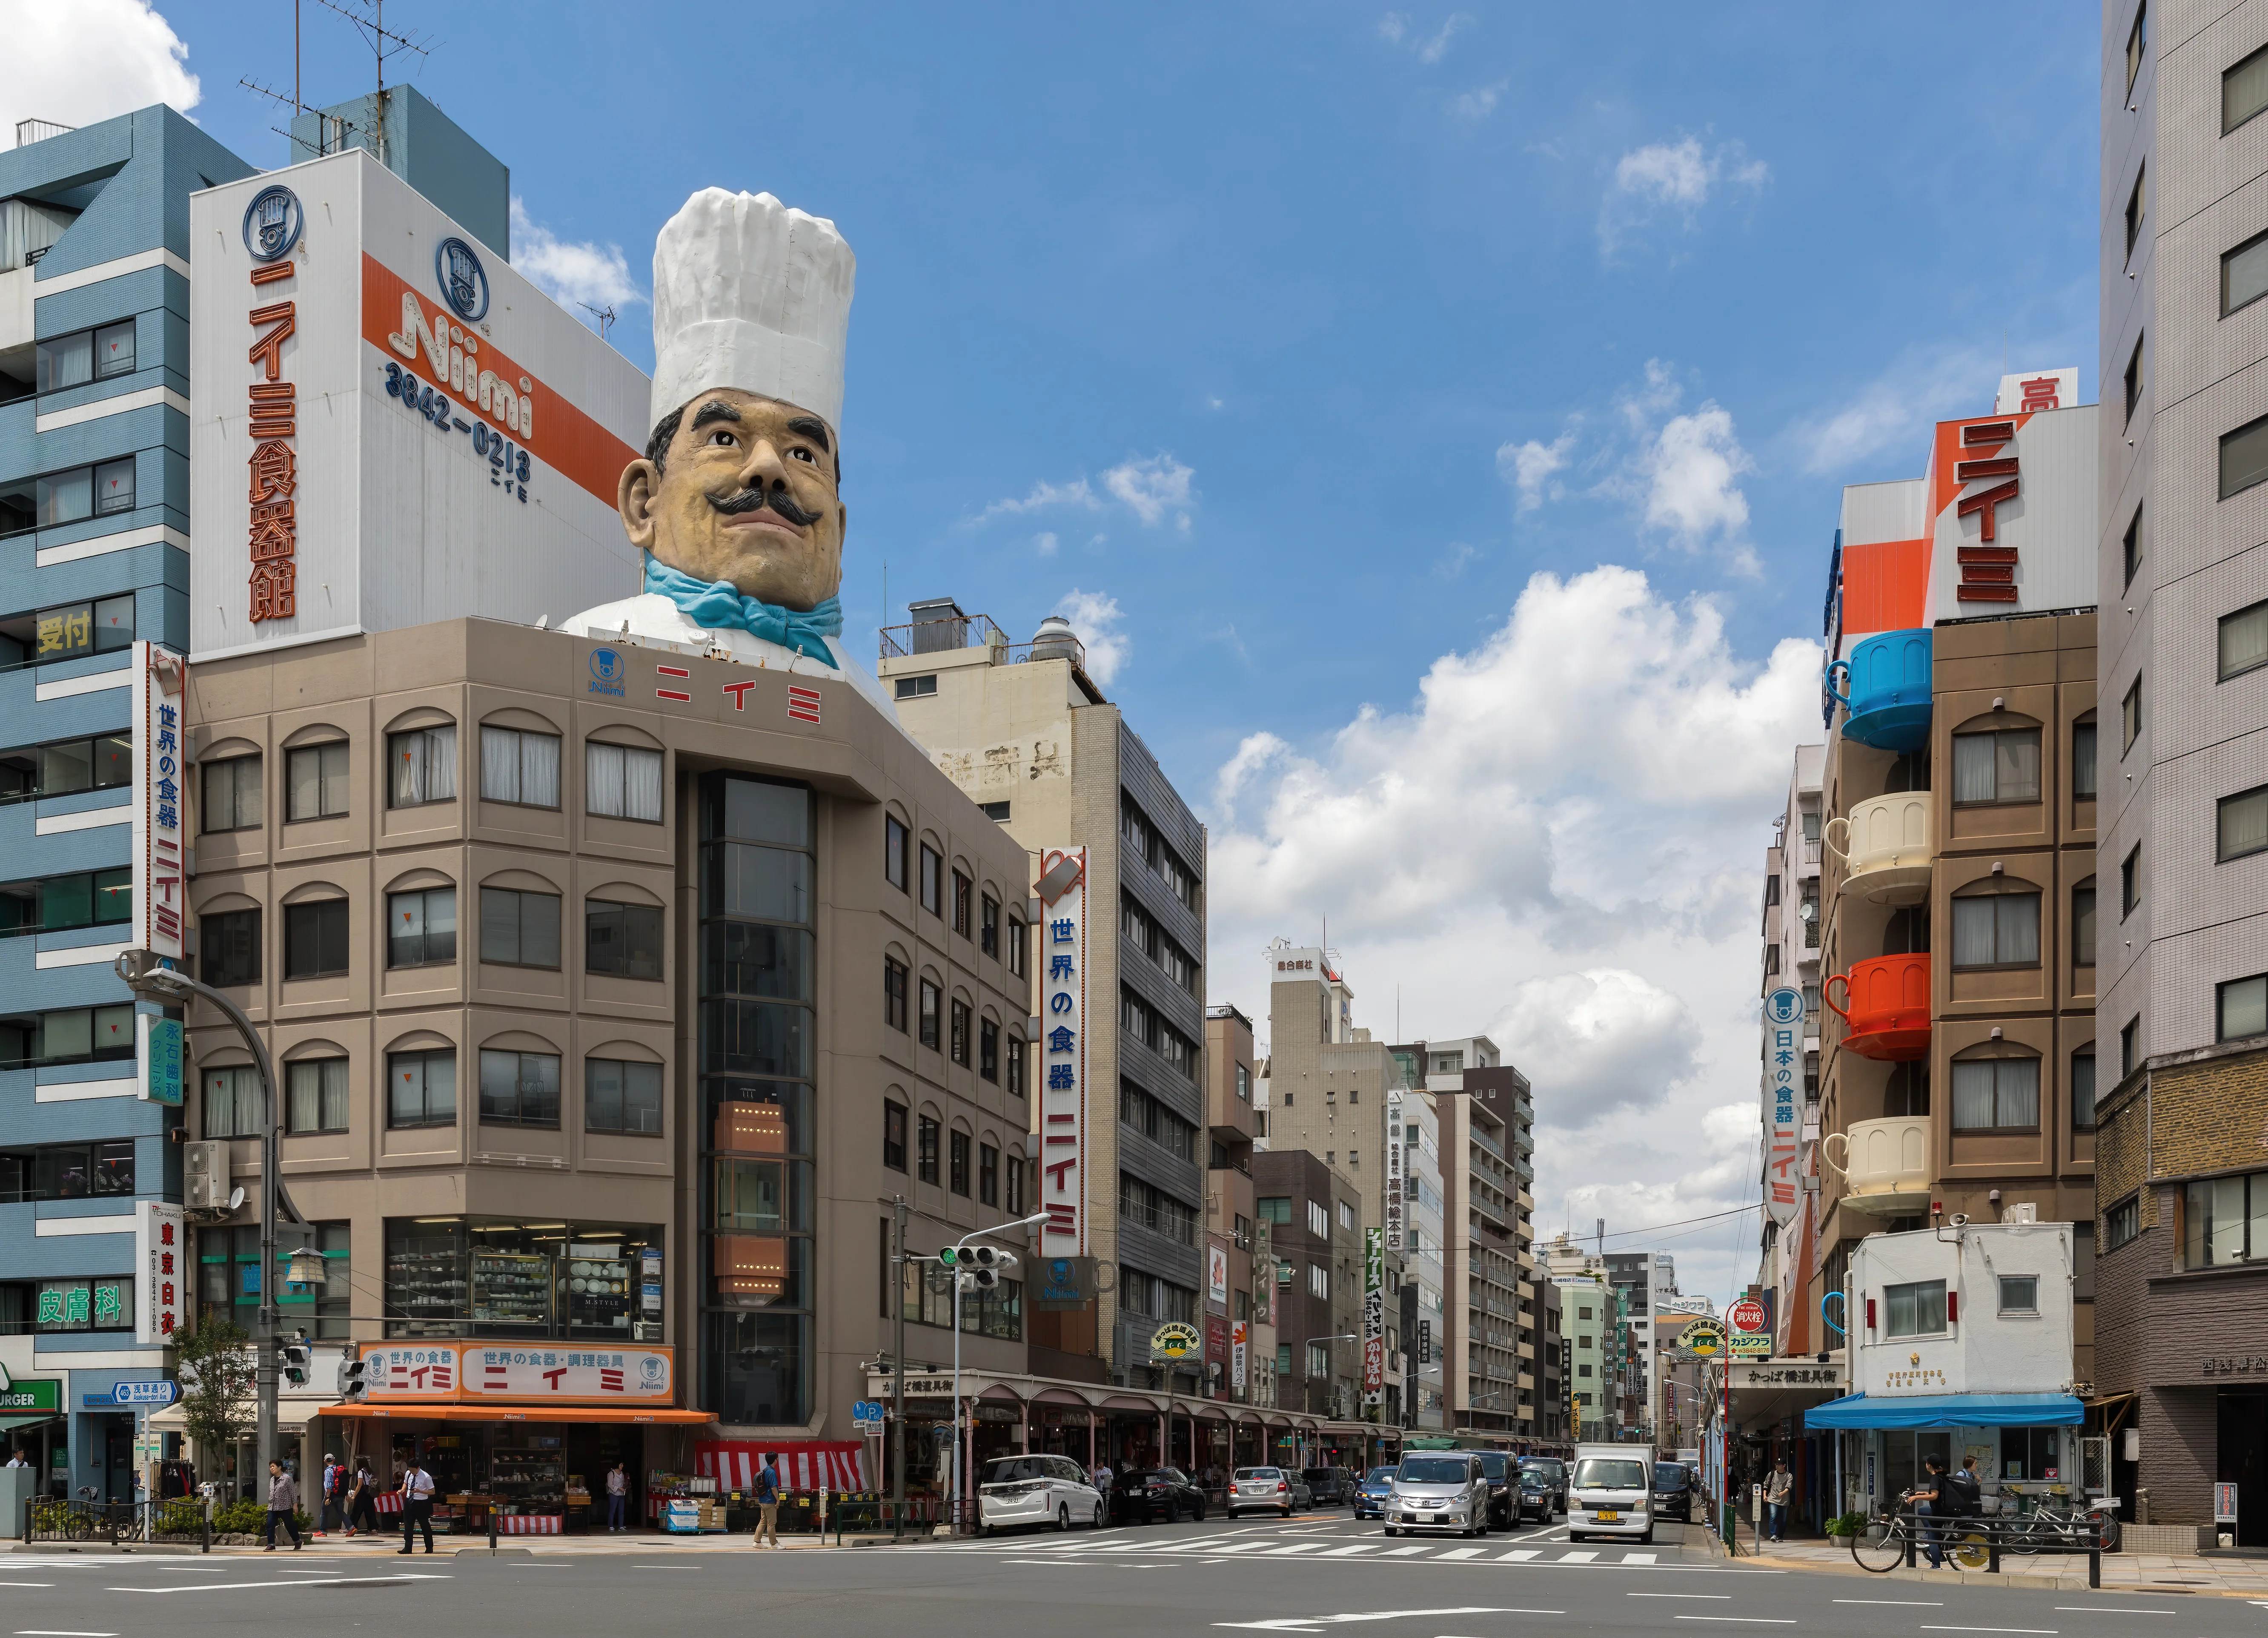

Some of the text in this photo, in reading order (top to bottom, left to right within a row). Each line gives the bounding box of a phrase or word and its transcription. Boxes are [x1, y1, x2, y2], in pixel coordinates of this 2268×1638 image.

[388, 292, 532, 439] Niimi
[249, 261, 297, 623] ニイミ食器館
[385, 362, 530, 482] 3842-0213
[1957, 422, 2019, 602] ニイミ
[38, 611, 90, 653] 受付
[588, 680, 625, 697] Niimi
[656, 665, 821, 724] ニイミ
[158, 703, 179, 830] 世界の食器
[153, 1040, 161, 1095] クリニック
[166, 1023, 179, 1100] 永石歯科
[1046, 918, 1077, 1235] 世界の食器 ニイミ
[1772, 1030, 1796, 1205] 日本の食器 ニイミ
[152, 1211, 180, 1219] TOHAKU
[1367, 1228, 1381, 1285] ショーケース
[160, 1222, 175, 1335] 東京白衣
[1041, 1286, 1079, 1299] Niimi
[38, 1285, 122, 1323] 皮膚科
[1736, 1311, 1761, 1322] 消火栓
[390, 1351, 452, 1364] 世界の食器
[1618, 1314, 1627, 1363] 山下食器
[1730, 1337, 1770, 1346] カジワラ
[390, 1365, 451, 1388] ニイミ
[484, 1352, 624, 1368] 世界の食器・調理器具
[484, 1367, 624, 1391] ニイミ
[1367, 1342, 1381, 1385] かんばん
[134, 1384, 167, 1394] 浅草通り
[369, 1378, 387, 1387] Niimi
[639, 1381, 664, 1390] Niimi
[869, 1408, 876, 1419] P
